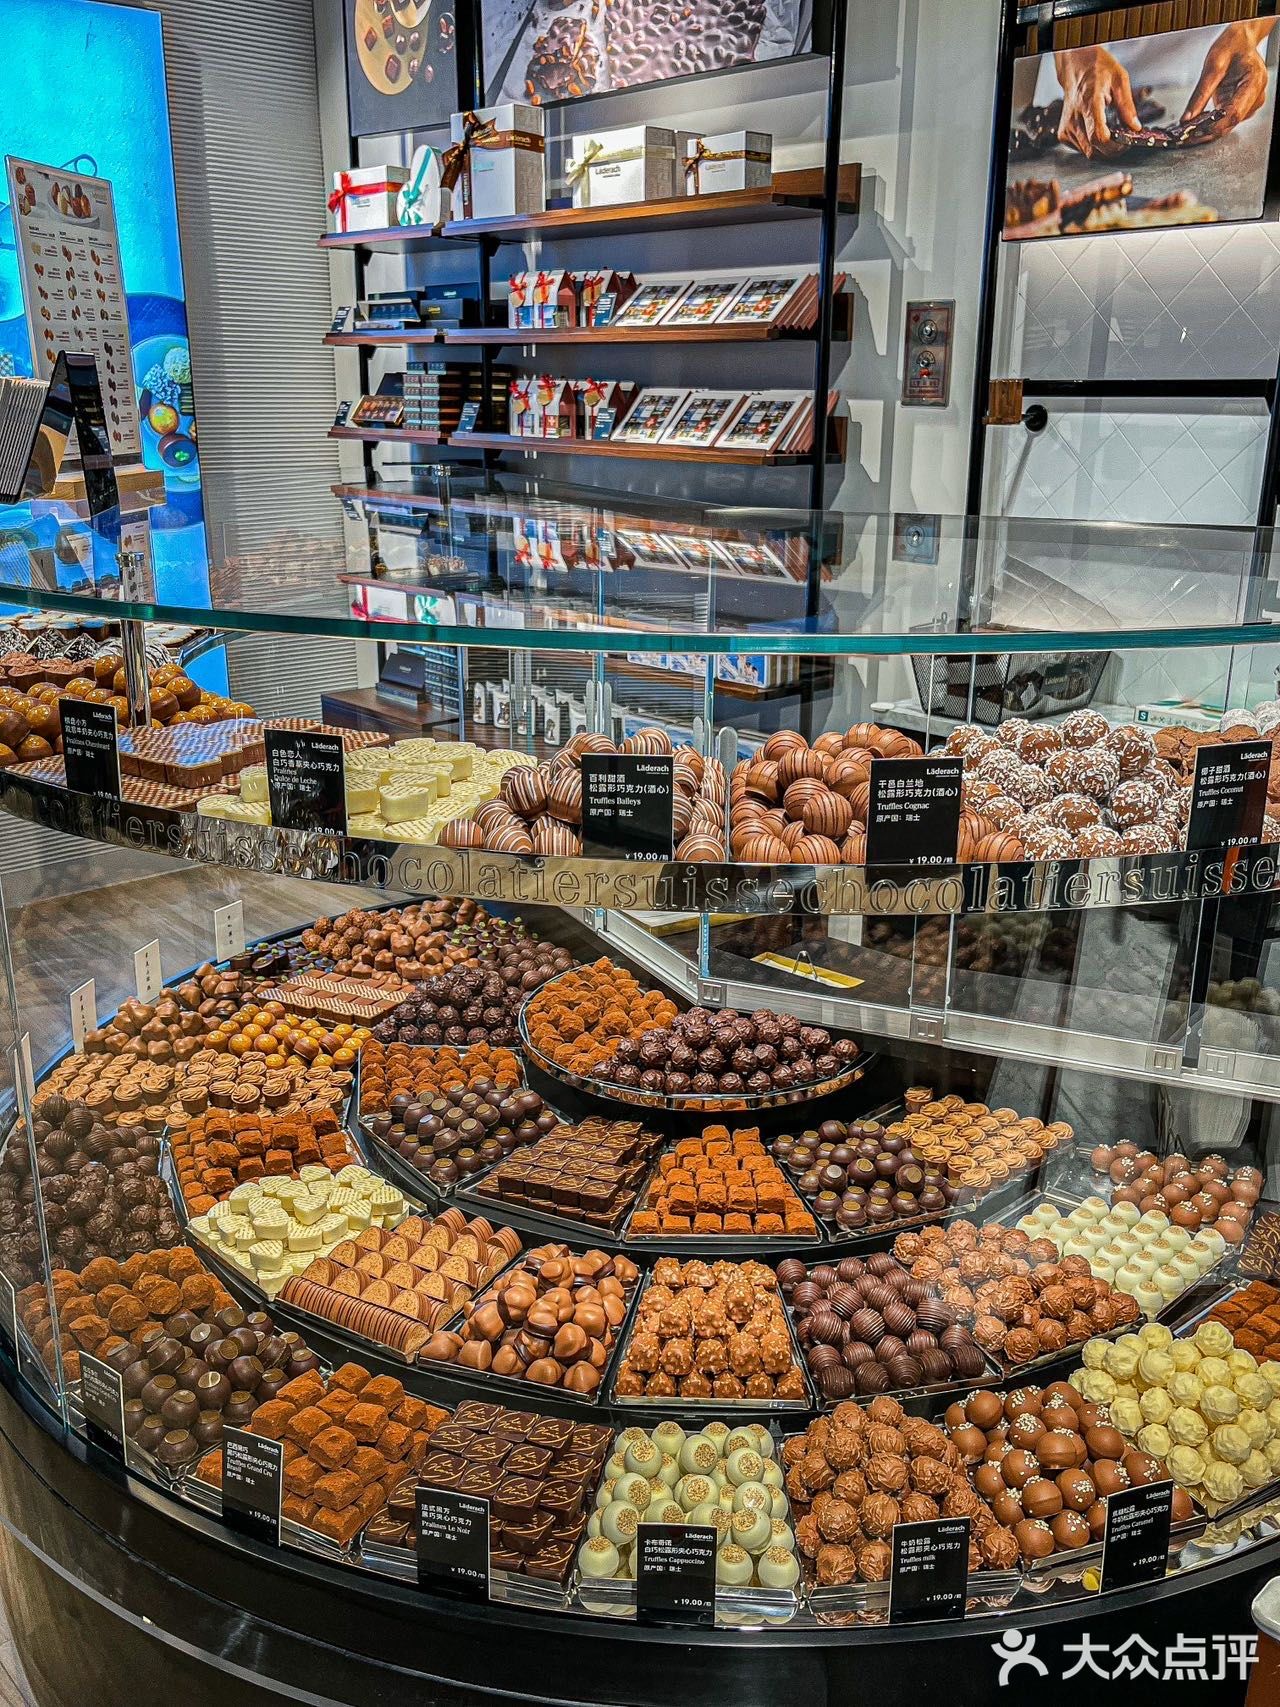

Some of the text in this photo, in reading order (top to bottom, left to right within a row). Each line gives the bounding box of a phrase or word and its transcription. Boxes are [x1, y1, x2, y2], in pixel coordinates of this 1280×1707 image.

[312, 742, 339, 750] Läderach
[1240, 751, 1268, 760] Läderach
[878, 779, 924, 788] 干邑白兰地
[589, 796, 642, 806] Truffles Baileys
[904, 802, 930, 811] Cognac
[263, 1468, 272, 1478] Cru
[456, 1526, 470, 1534] Noir
[668, 1556, 704, 1564] Cappuccino
